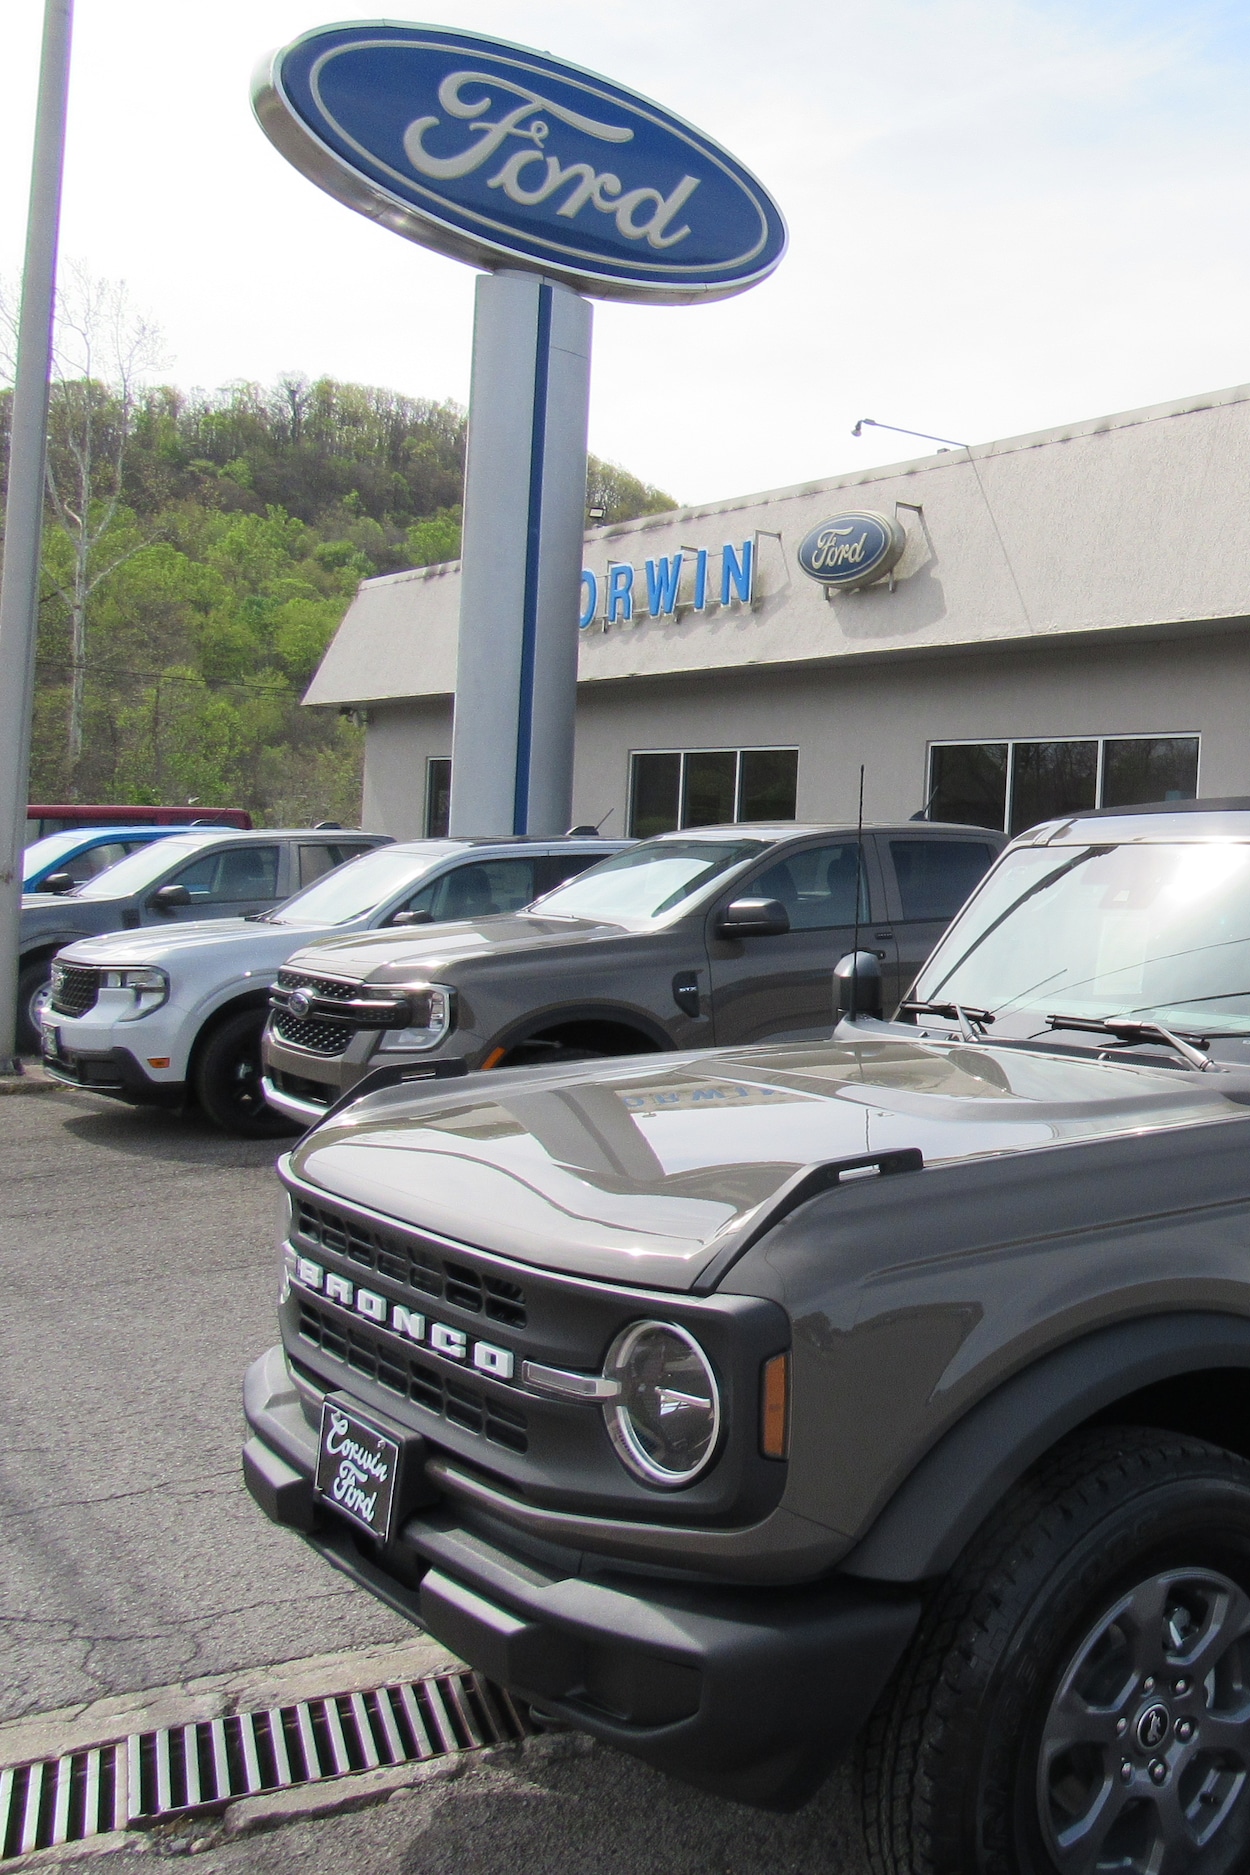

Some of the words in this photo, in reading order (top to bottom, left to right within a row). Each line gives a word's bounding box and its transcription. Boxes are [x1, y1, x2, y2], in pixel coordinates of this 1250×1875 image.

[403, 71, 700, 249] Ford
[579, 538, 754, 630] ORWIN
[812, 527, 867, 569] Ford
[299, 1256, 514, 1379] BRONCO
[326, 1412, 388, 1482] Corwin
[333, 1460, 377, 1522] Ford
